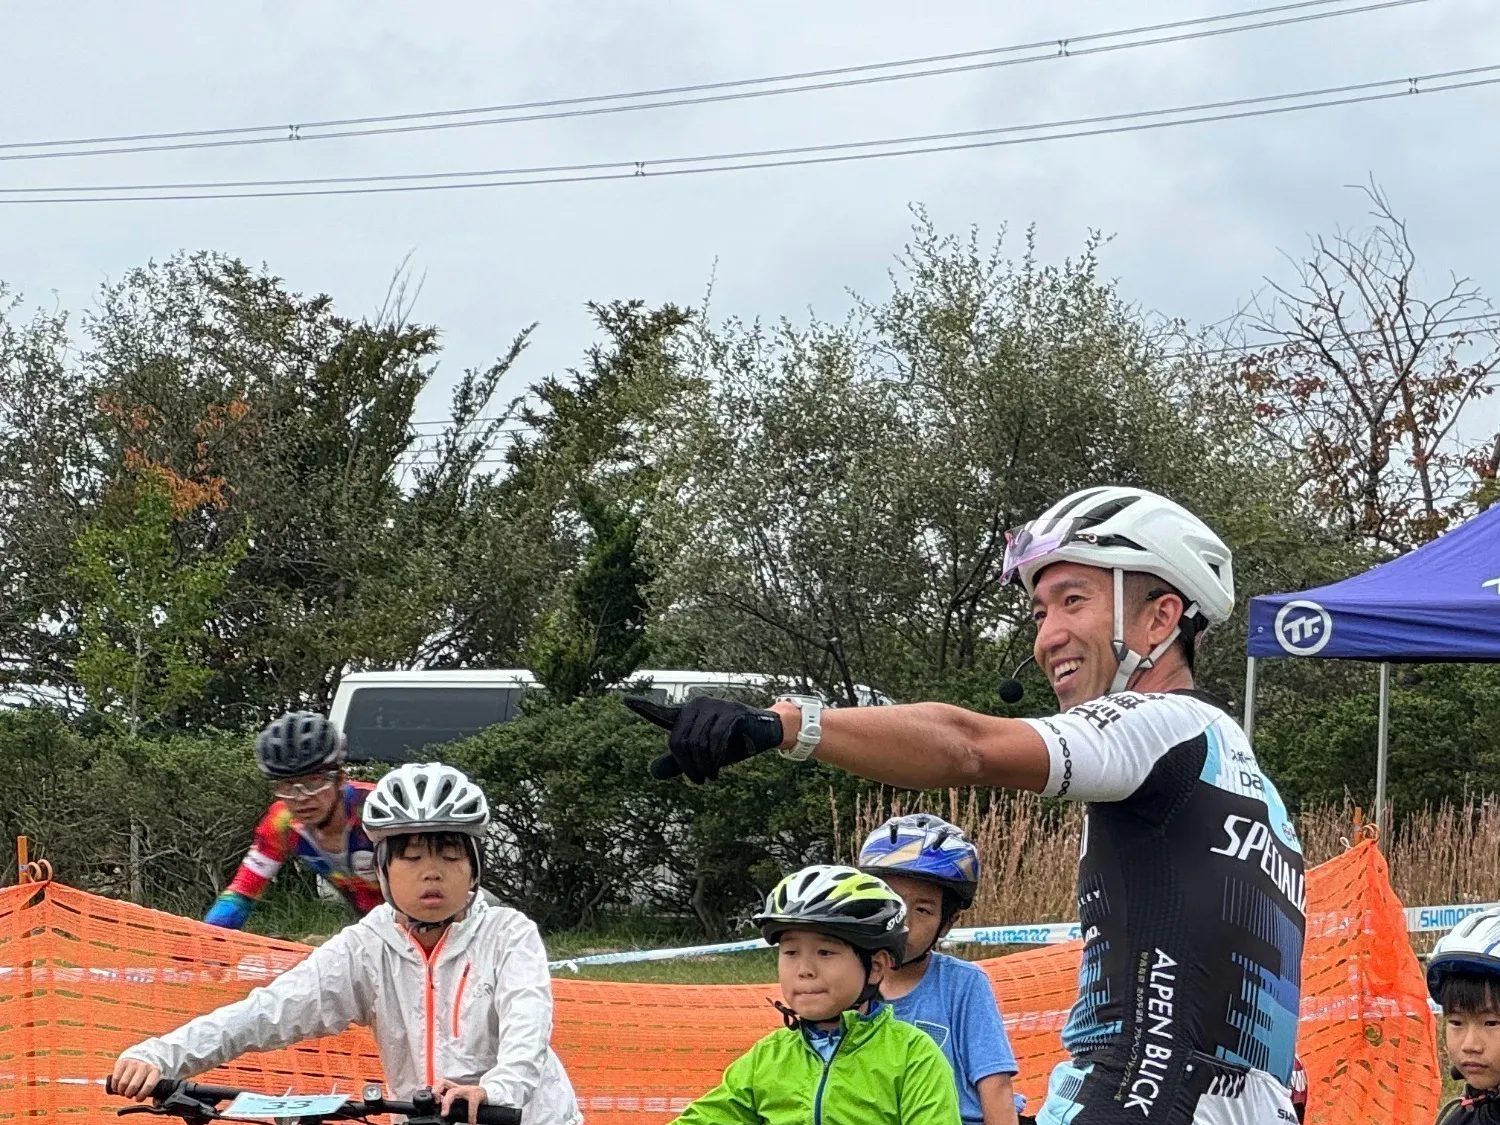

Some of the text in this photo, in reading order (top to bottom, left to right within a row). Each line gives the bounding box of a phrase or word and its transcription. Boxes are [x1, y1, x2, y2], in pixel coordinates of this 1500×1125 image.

[1123, 947, 1178, 1118] ALPEN BLICK
[262, 1101, 313, 1110] 33
